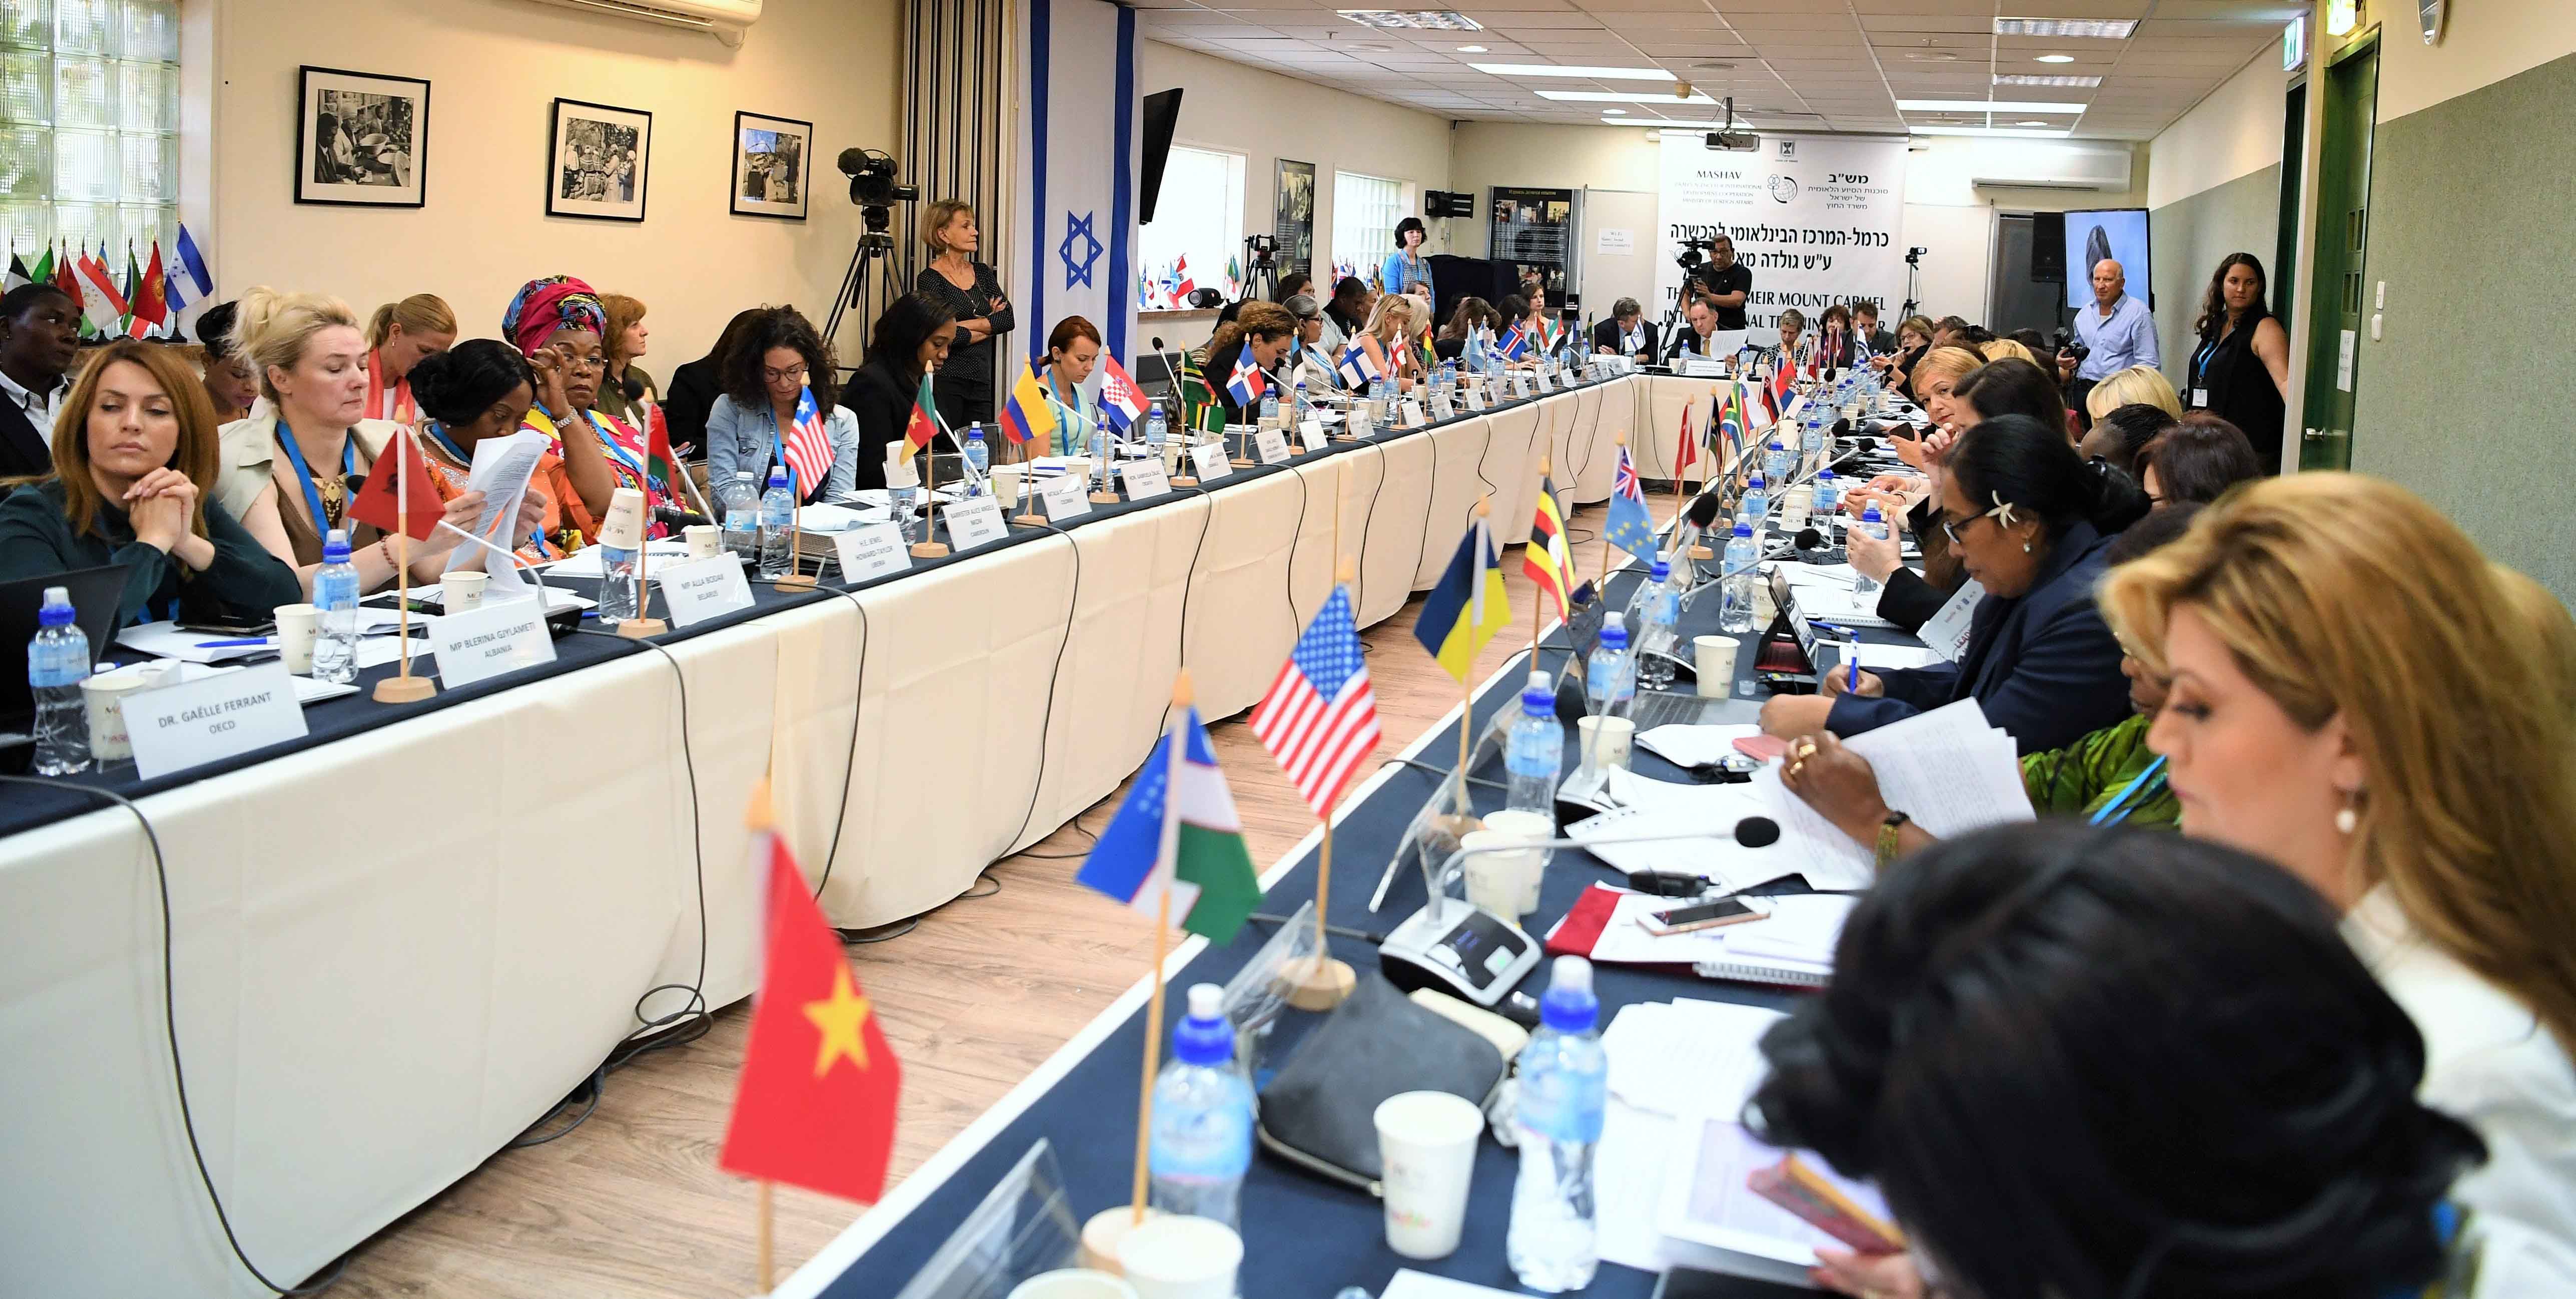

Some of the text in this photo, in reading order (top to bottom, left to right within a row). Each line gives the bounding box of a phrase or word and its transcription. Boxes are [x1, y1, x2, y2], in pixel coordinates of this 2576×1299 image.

[1697, 170, 1742, 179] MASHAV
[1731, 223, 1797, 243] הבינלאומי
[1761, 250, 1799, 269] גולדה
[1778, 292, 1830, 307] MOUNT
[449, 642, 462, 652] MP
[464, 633, 495, 648] BLERINA
[484, 644, 512, 658] ALBANIA
[158, 691, 272, 728] DR. GAËLLE FERRANT
[209, 720, 236, 734] OECD
